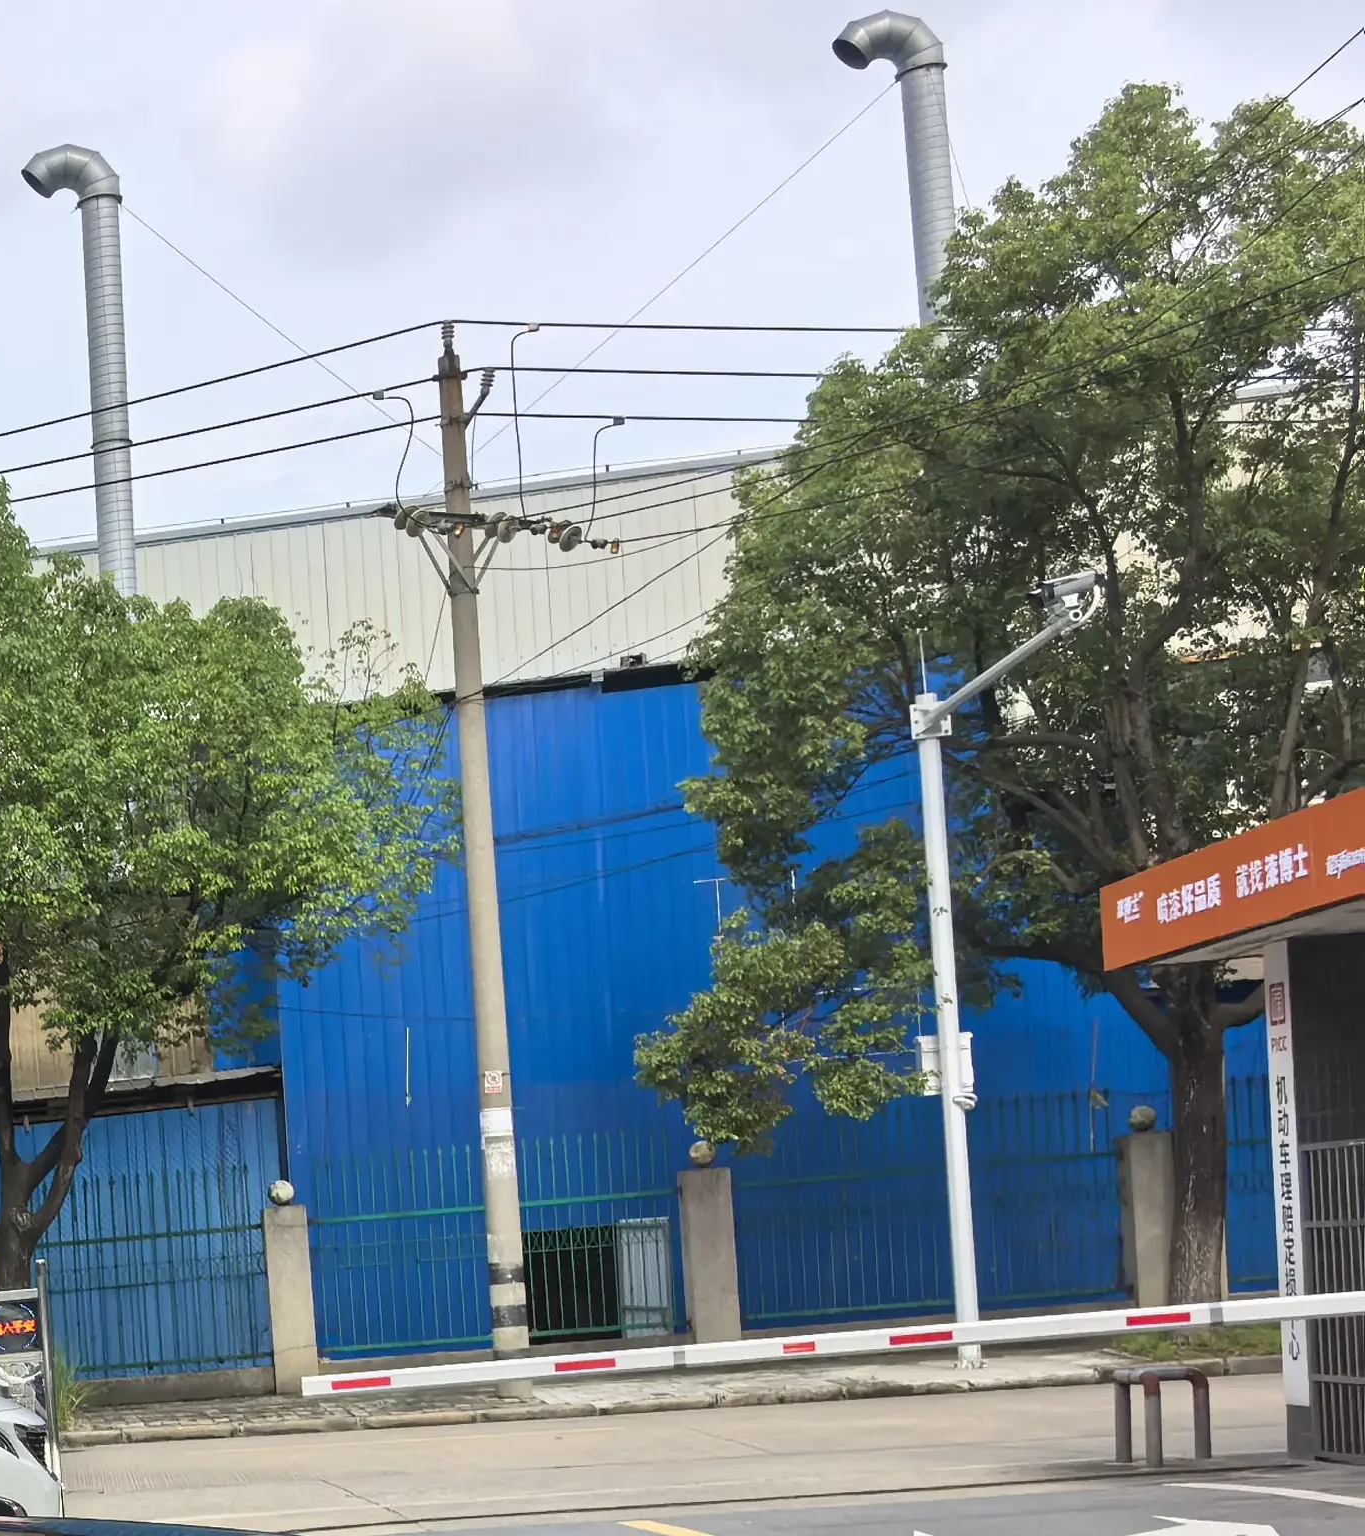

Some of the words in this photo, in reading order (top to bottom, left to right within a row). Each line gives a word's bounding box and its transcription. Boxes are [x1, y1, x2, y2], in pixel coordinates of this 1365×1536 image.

[1156, 873, 1222, 924] 喷漆好品质
[1235, 843, 1309, 899] 就找漆博士
